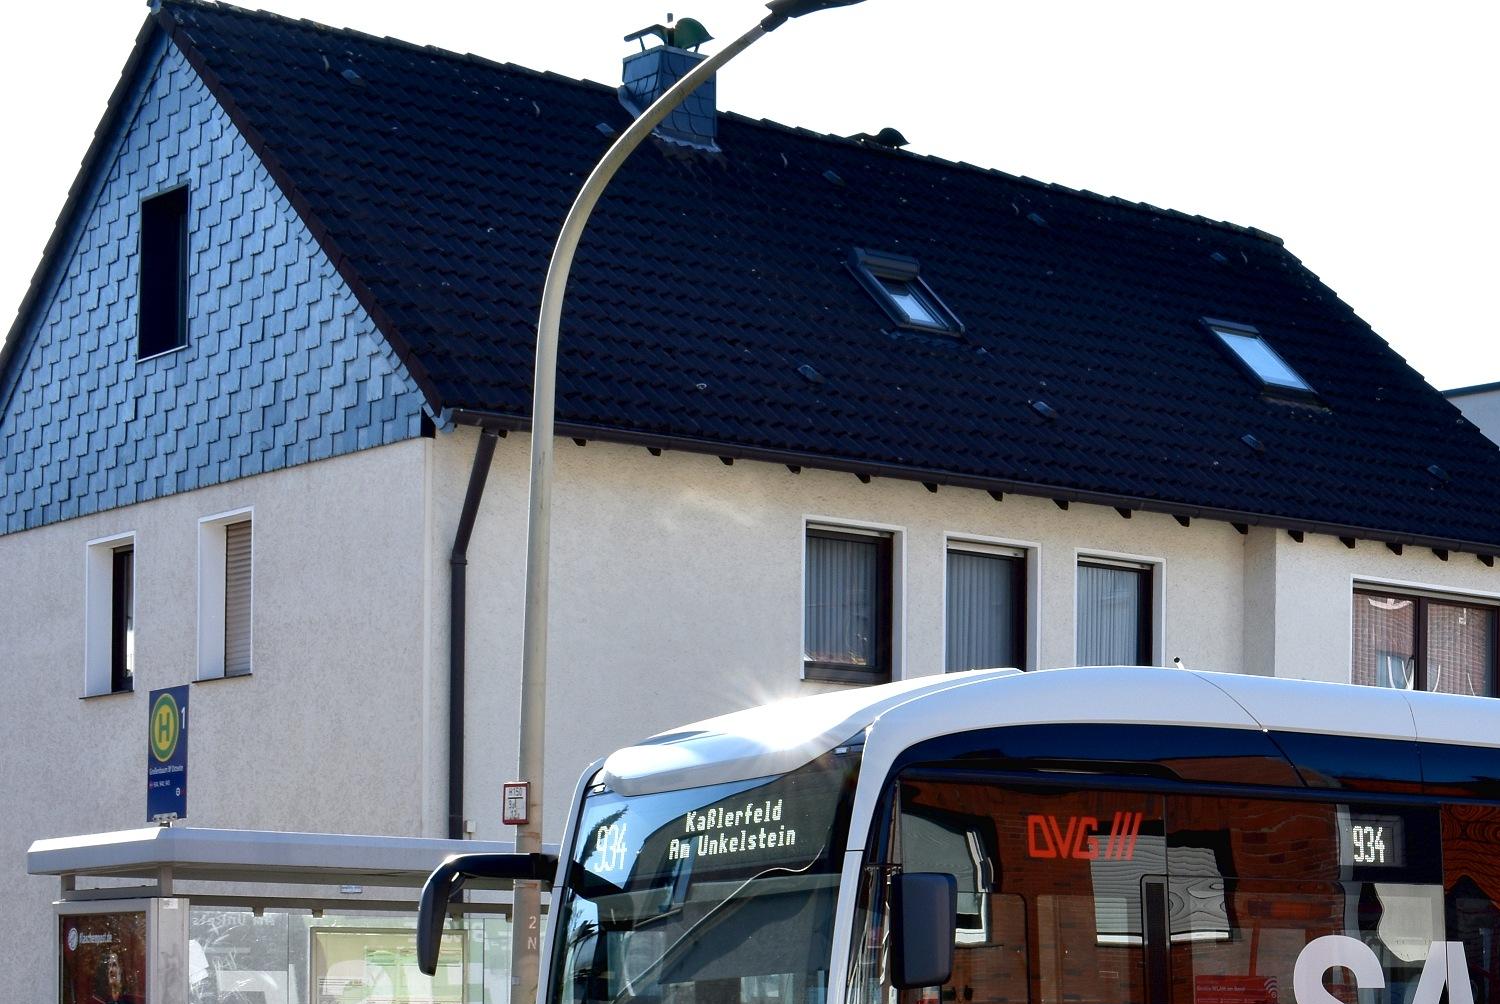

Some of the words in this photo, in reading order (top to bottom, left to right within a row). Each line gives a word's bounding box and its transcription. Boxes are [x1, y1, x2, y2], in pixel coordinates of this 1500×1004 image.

[159, 711, 170, 743] H
[181, 706, 186, 729] 1
[685, 799, 783, 833] Kaßlerfeld
[595, 823, 628, 873] 934
[668, 839, 690, 860] Am
[697, 825, 796, 857] Unkelstein
[1027, 814, 1099, 859] DVG
[1352, 825, 1386, 863] 934
[528, 915, 537, 929] 2
[527, 936, 538, 950] N
